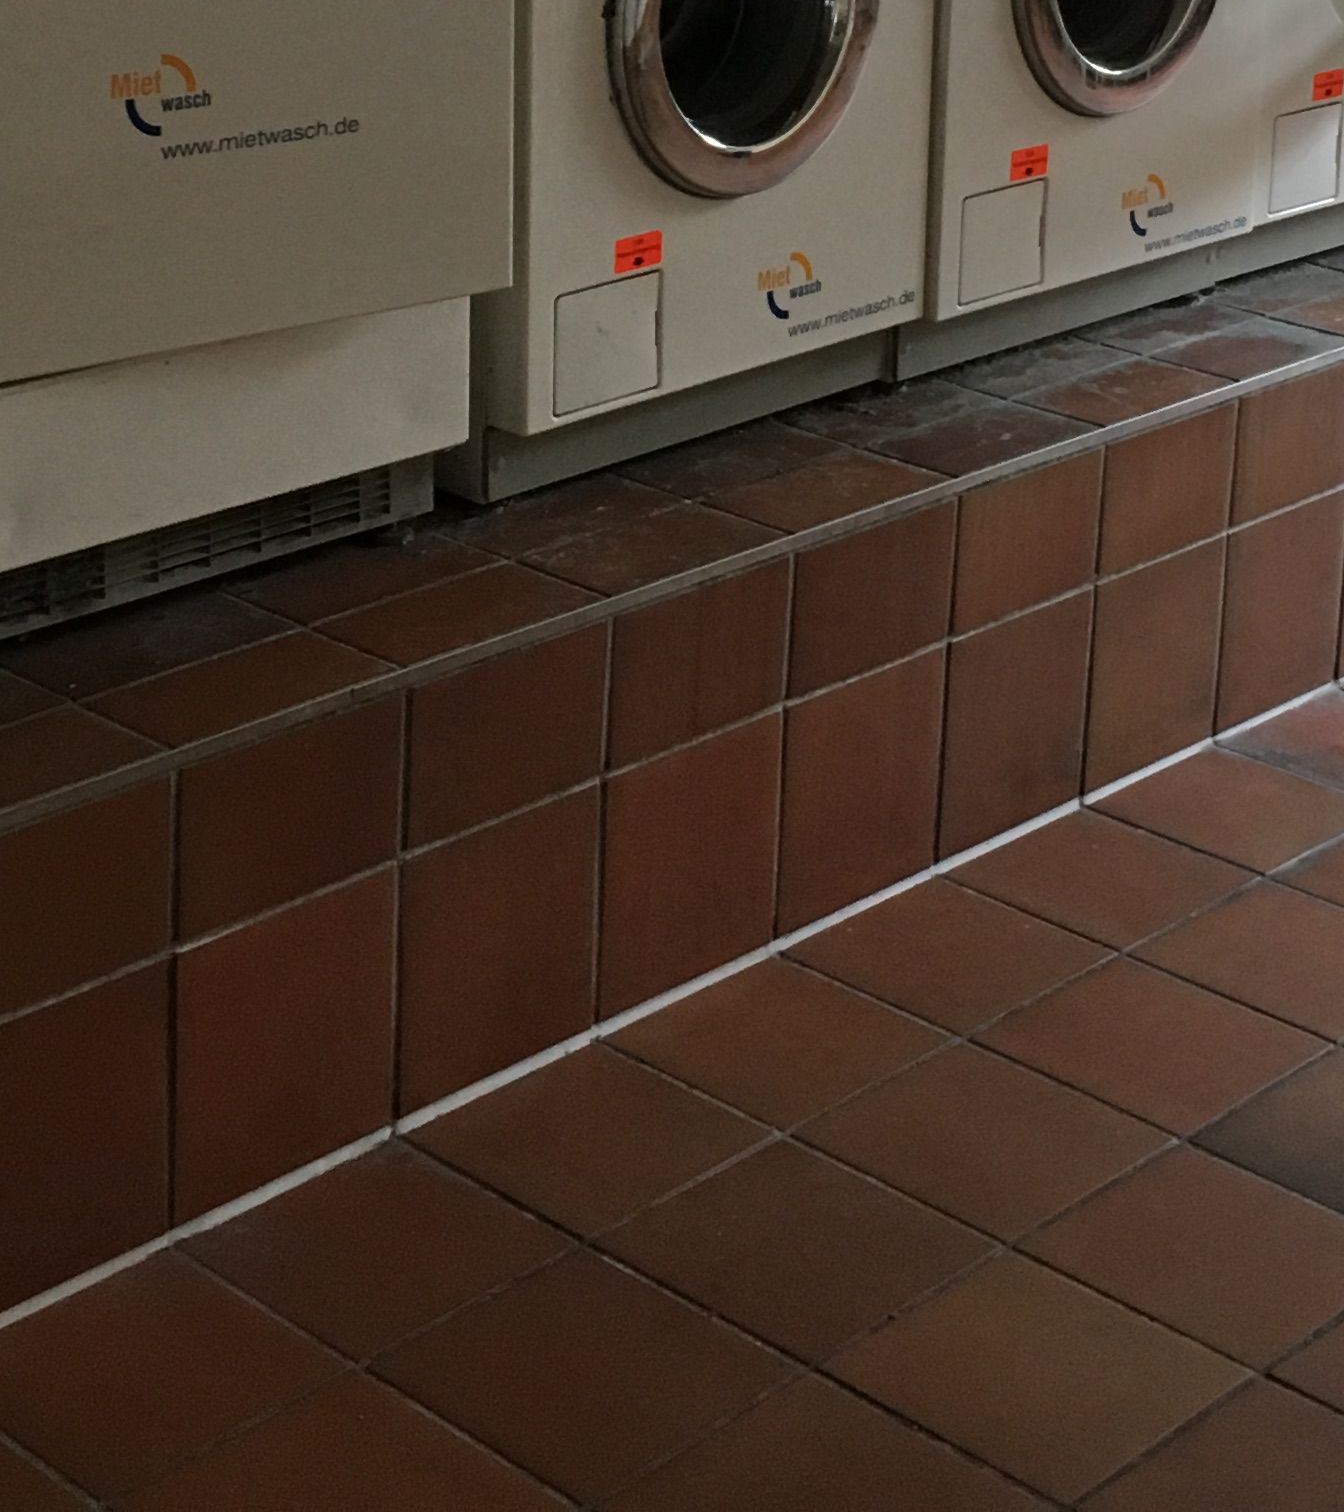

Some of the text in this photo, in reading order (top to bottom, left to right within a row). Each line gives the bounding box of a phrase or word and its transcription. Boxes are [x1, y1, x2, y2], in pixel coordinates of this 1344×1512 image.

[110, 70, 162, 100] Miet
[161, 89, 212, 113] wasch
[161, 117, 360, 160] www.mietwasch.de
[1121, 186, 1148, 210] Miet
[1145, 216, 1248, 253] www.mietwasch.de
[757, 266, 791, 291] Miet
[789, 279, 822, 300] wasch
[787, 290, 916, 338] www.mietwasch.de
